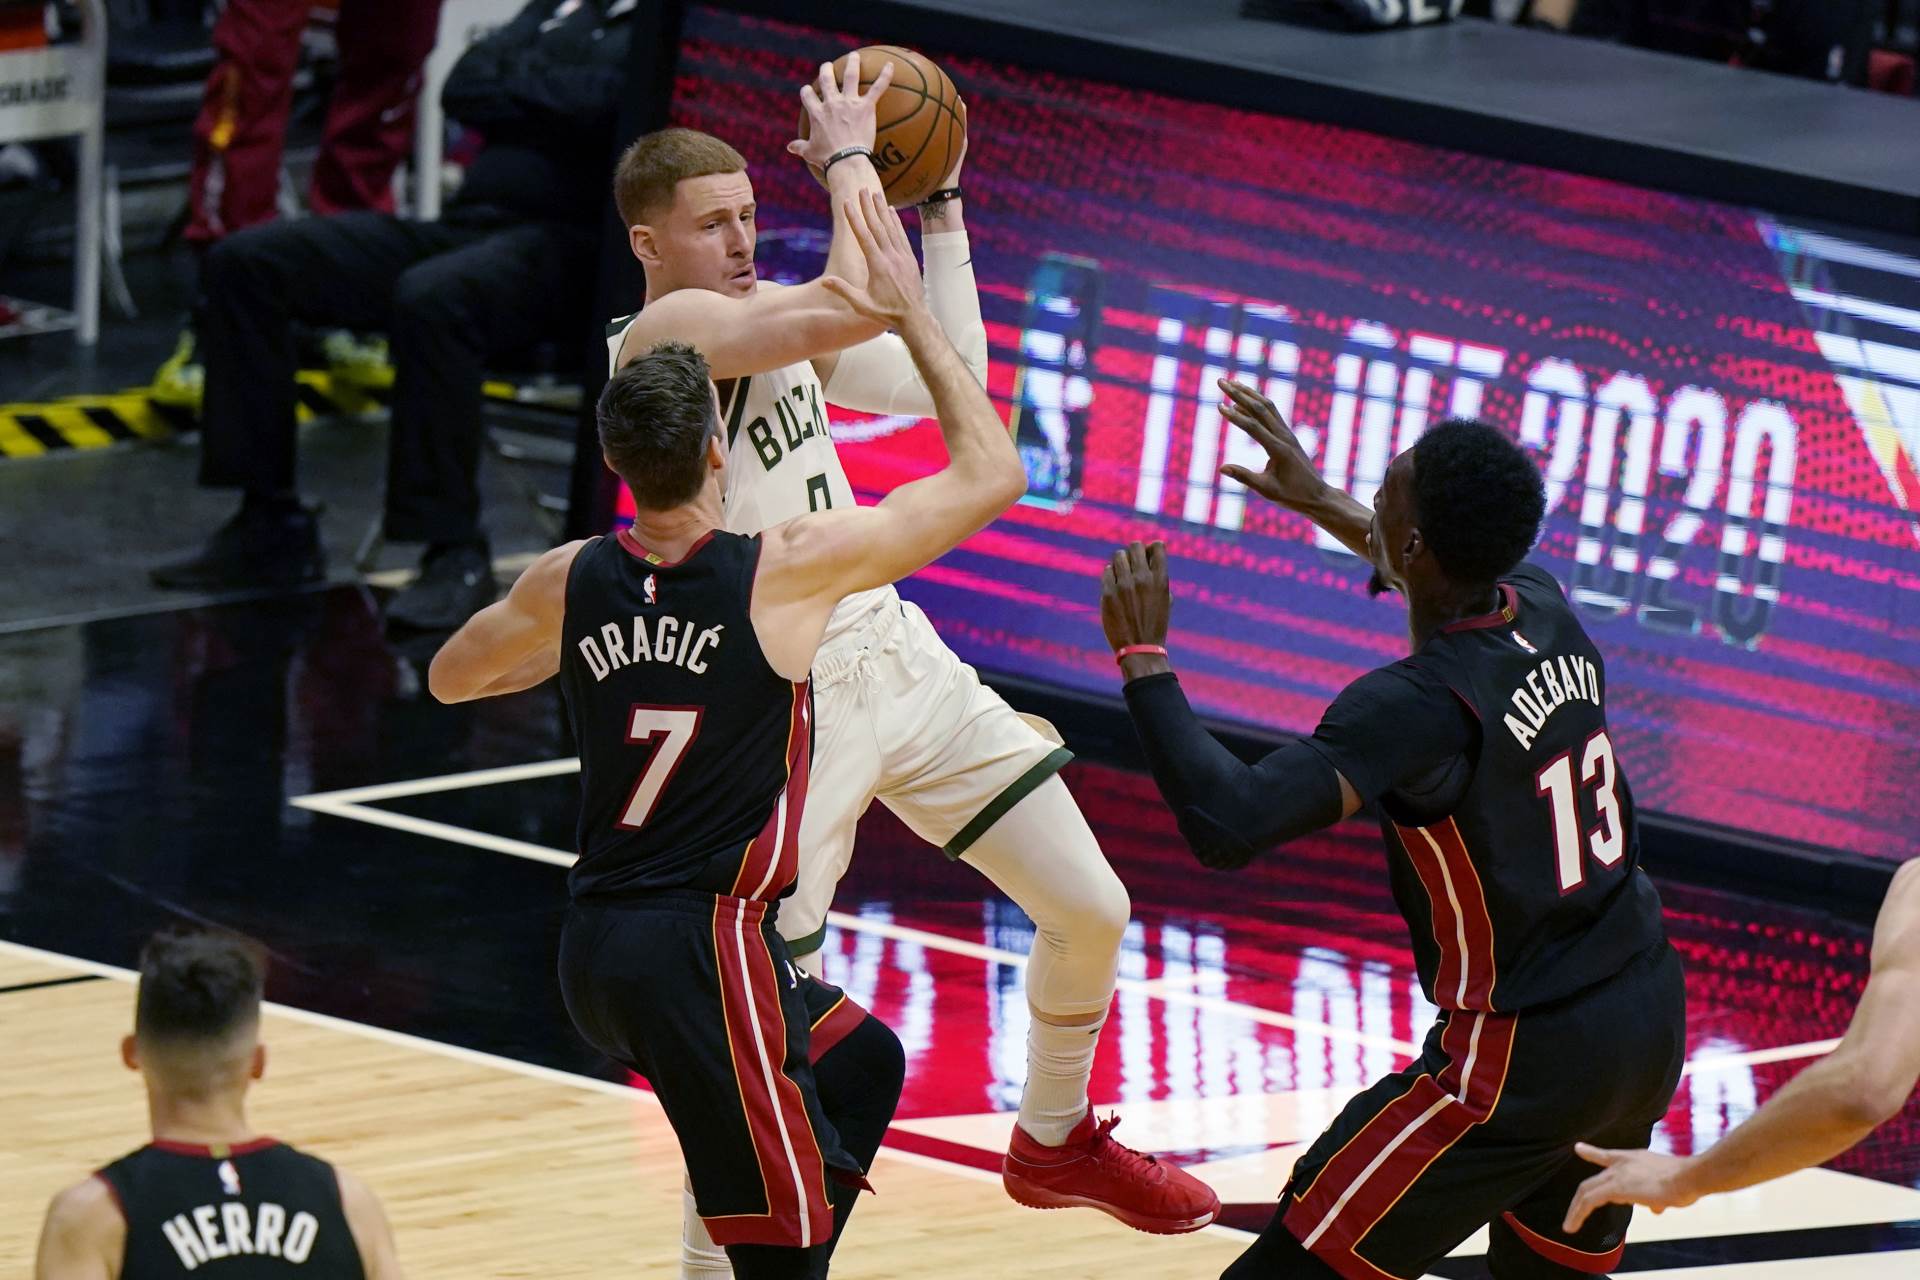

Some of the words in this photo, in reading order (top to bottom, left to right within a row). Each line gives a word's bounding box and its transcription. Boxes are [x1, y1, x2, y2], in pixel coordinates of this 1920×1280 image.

[1134, 285, 1508, 562] TIP-O
[577, 615, 725, 682] DRAGIĆ
[1502, 653, 1601, 751] ADEBAYO
[613, 702, 706, 832] 7
[1535, 726, 1627, 897] 13
[161, 1201, 320, 1271] HERRO
